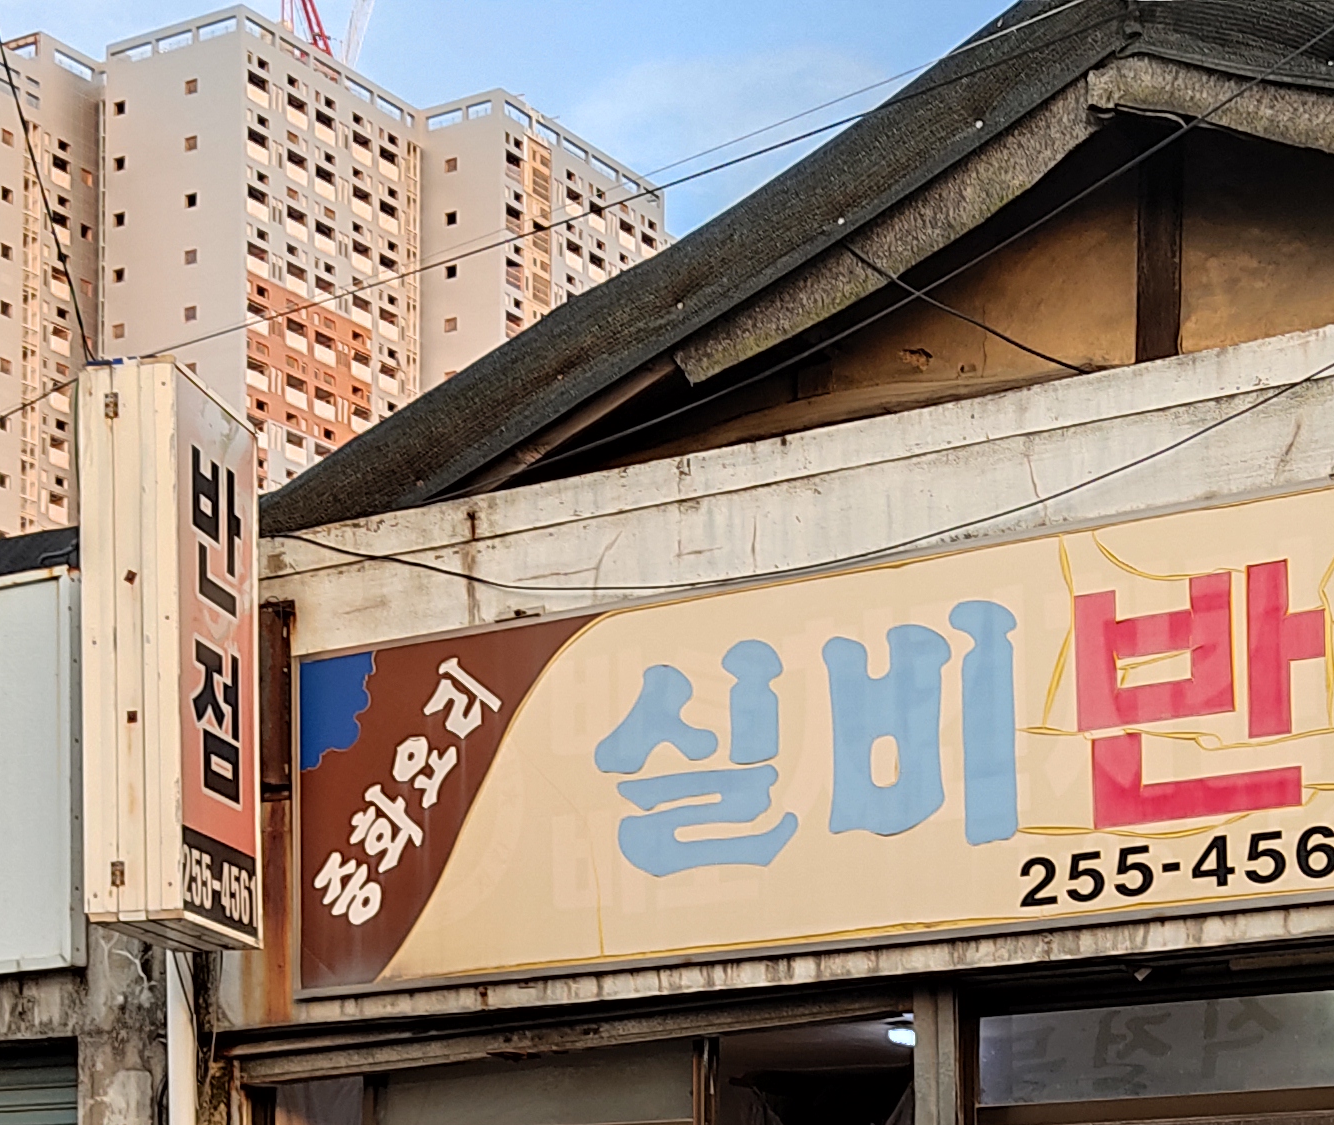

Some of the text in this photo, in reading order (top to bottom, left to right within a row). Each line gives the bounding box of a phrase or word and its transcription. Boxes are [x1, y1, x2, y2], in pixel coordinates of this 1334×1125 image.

[189, 442, 243, 811] 반점
[182, 843, 257, 928] 255-4561
[313, 656, 502, 925] 중화요리
